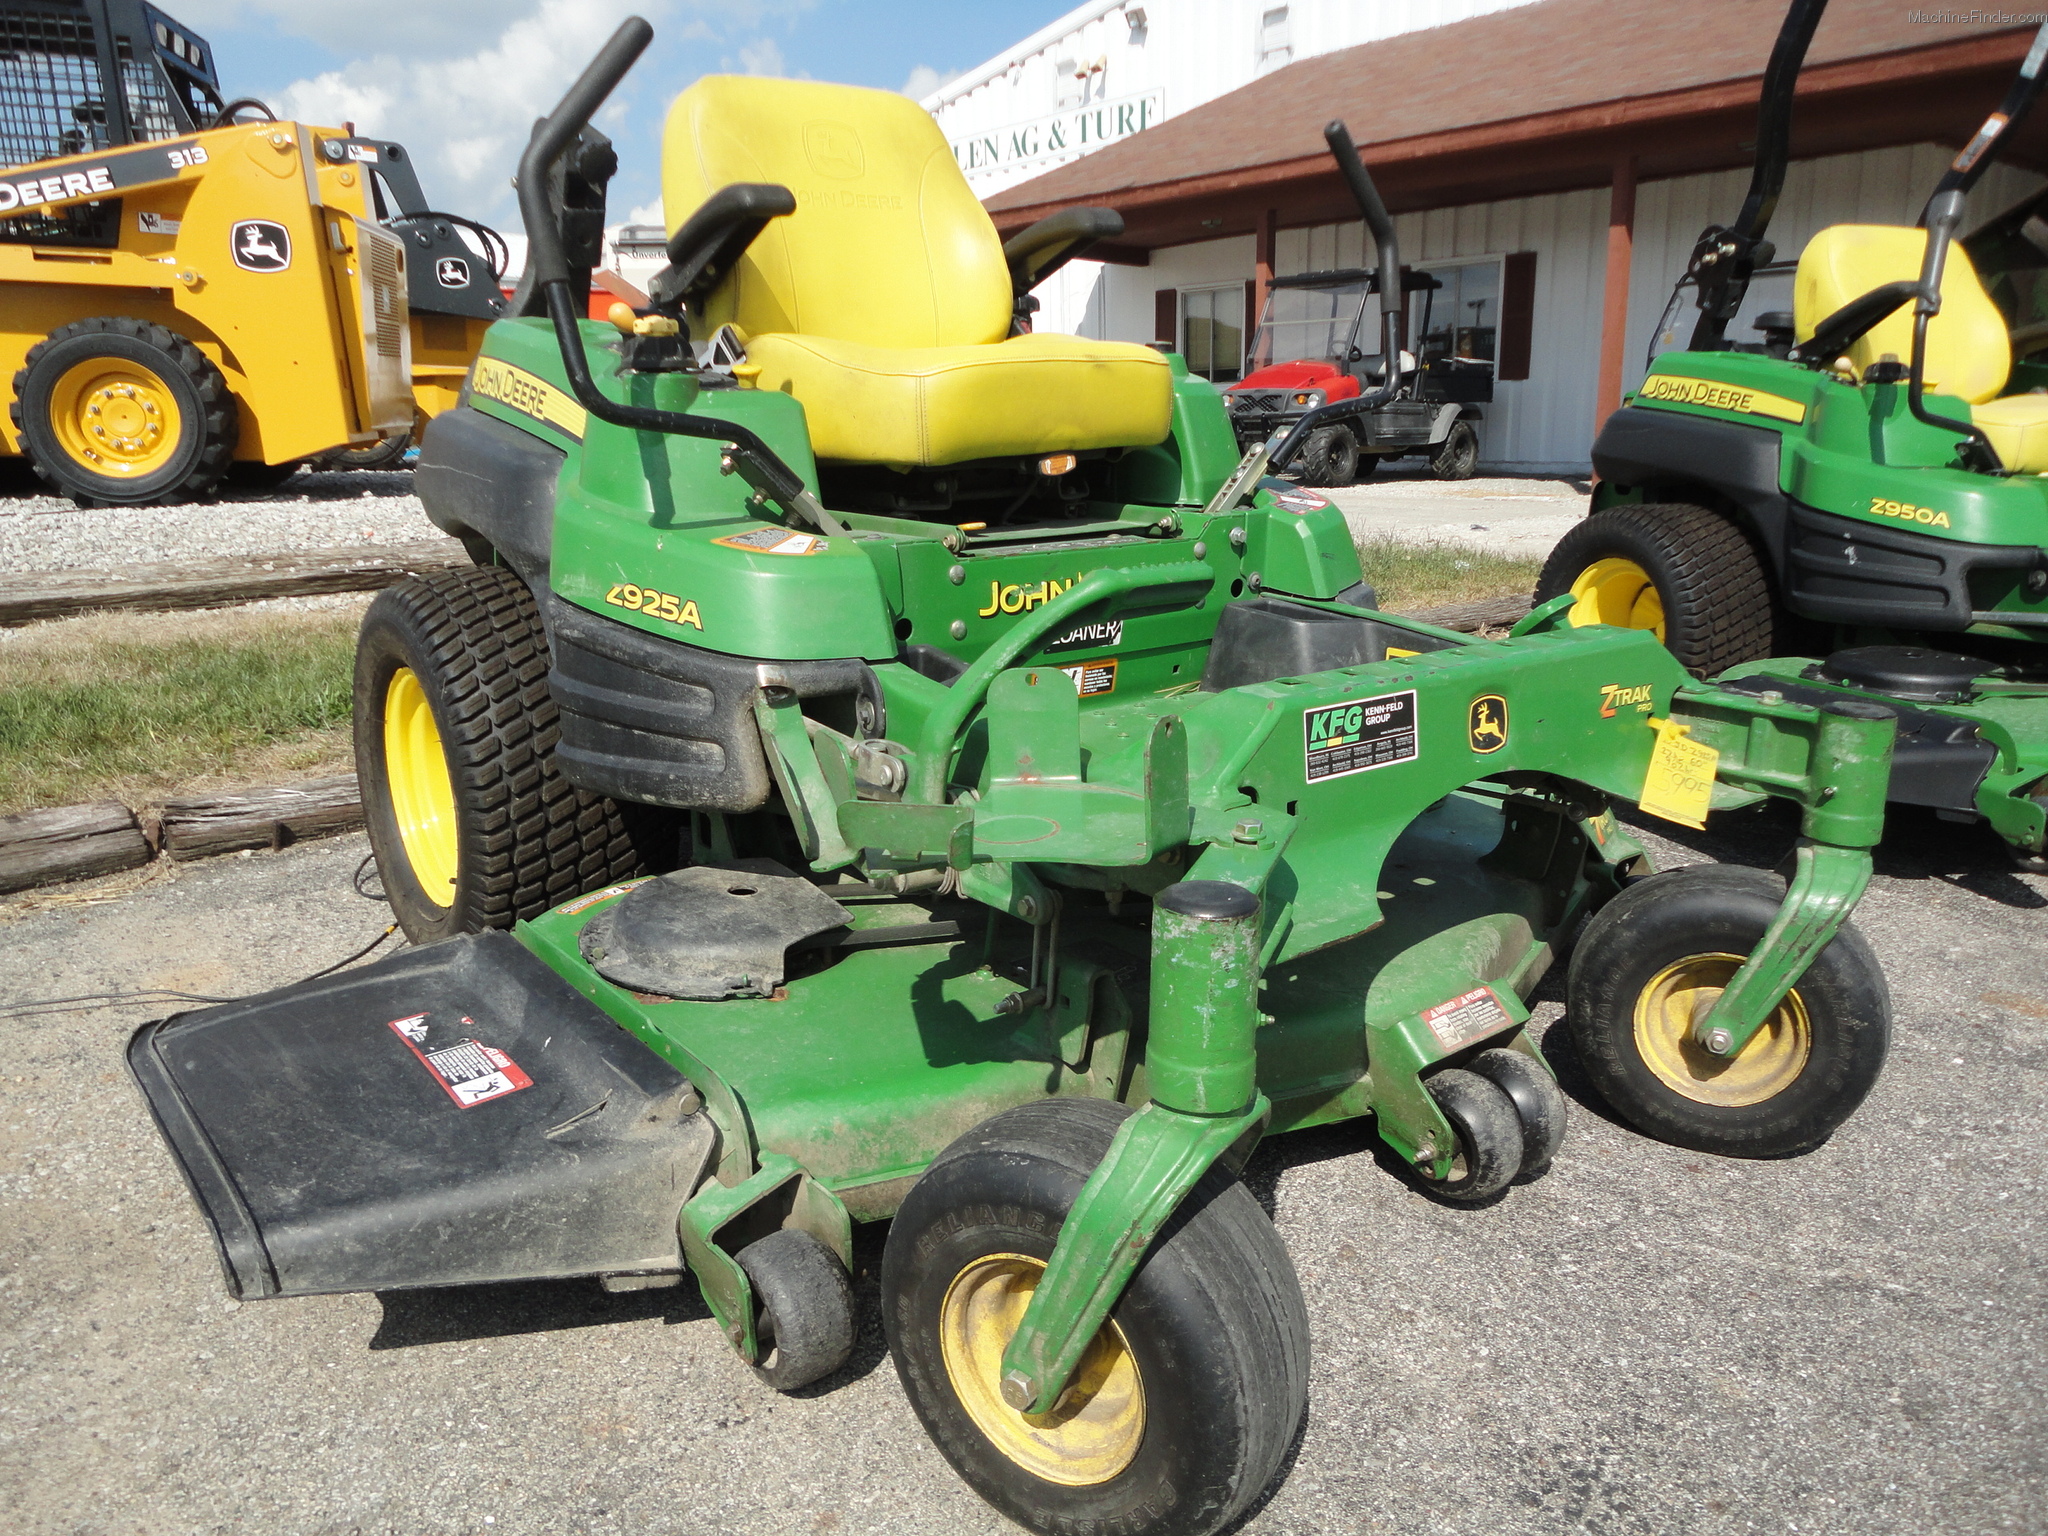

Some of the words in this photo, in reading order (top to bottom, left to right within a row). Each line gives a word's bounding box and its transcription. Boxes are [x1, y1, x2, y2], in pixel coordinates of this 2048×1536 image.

[1008, 124, 1039, 160] AG
[1048, 118, 1068, 151] &
[1075, 96, 1157, 144] TURF
[167, 146, 209, 170] 313
[0, 166, 116, 212] DEERE
[472, 361, 505, 401] JOHN
[502, 369, 548, 419] DEERE
[1646, 378, 1693, 402] JOHN
[1693, 382, 1755, 412] DEERE
[1869, 497, 1951, 529] Z950A
[1052, 620, 1117, 645] ANER
[1365, 701, 1404, 716] KENN-FELD
[1365, 713, 1391, 726] GROUP
[1636, 702, 1653, 713] PRO
[1310, 705, 1363, 741] KFG
[1465, 987, 1488, 1002] PELIGRO
[1435, 1000, 1457, 1015] DANGER
